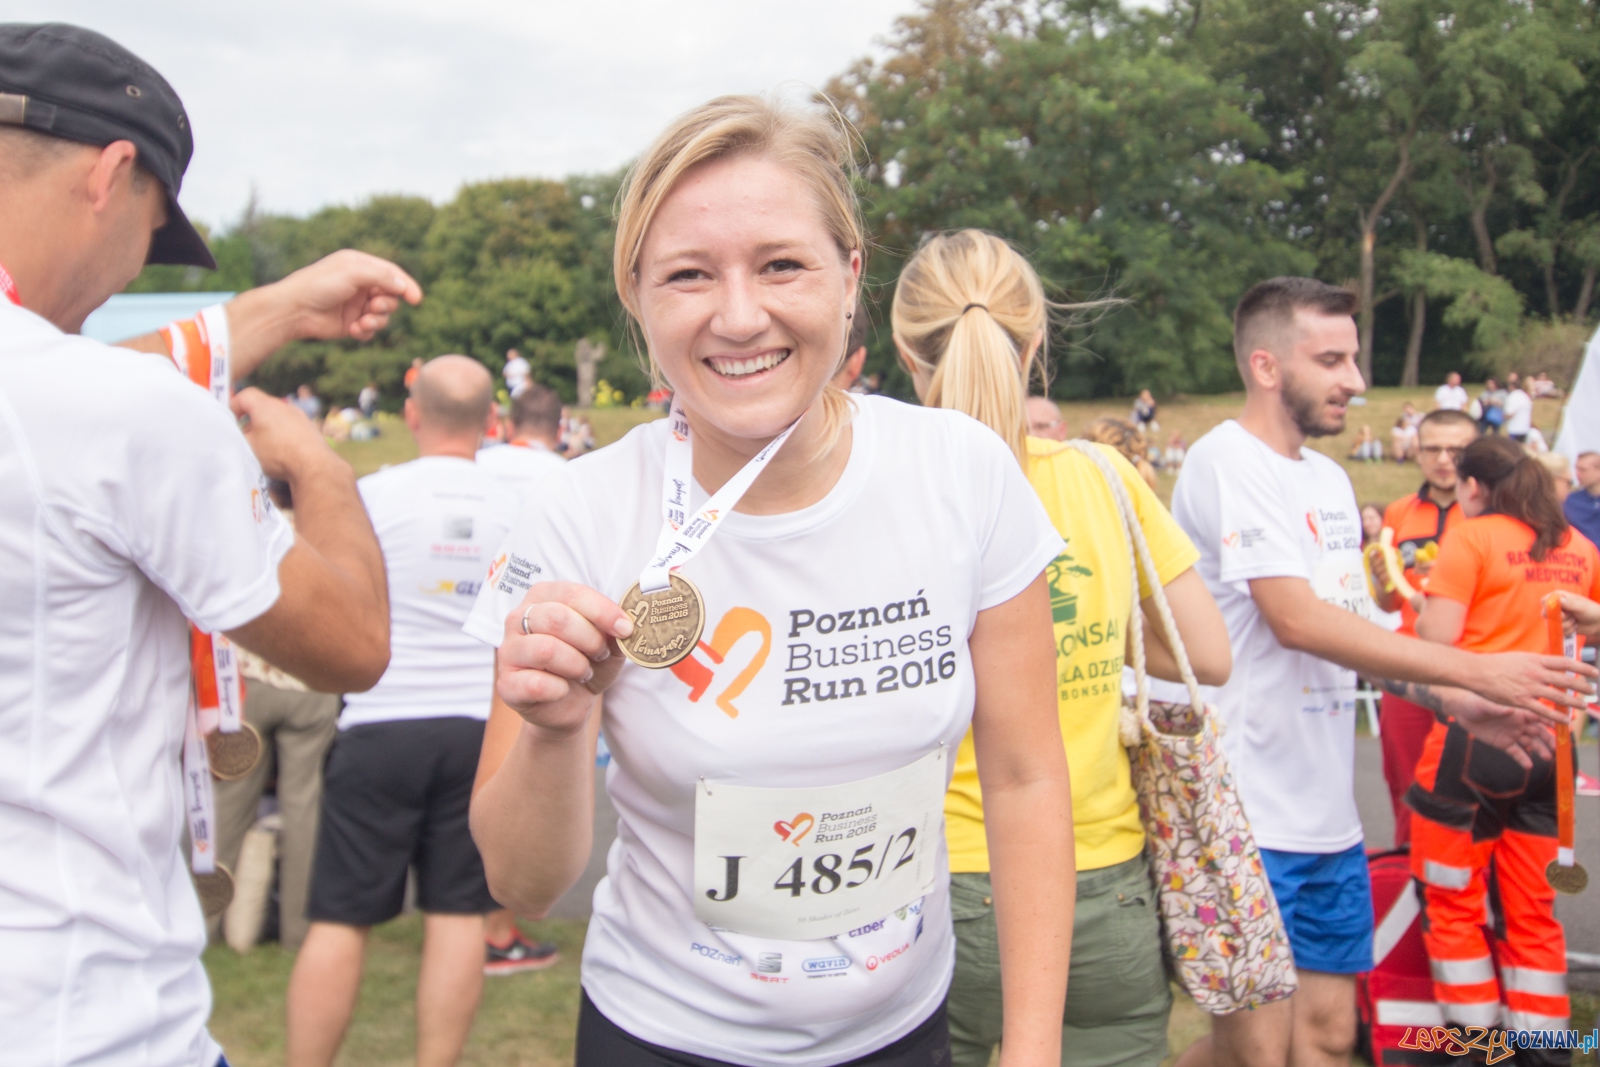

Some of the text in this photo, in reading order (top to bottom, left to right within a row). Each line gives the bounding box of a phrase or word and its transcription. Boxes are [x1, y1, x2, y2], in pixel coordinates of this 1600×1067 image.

[497, 581, 513, 594] Run
[501, 571, 533, 591] Busines
[650, 594, 684, 608] Poznań
[650, 601, 688, 616] Business
[650, 609, 689, 624] Run 2016
[788, 589, 931, 638] Poznań
[785, 625, 953, 672] Business
[1056, 618, 1119, 659] ONSAI
[781, 651, 957, 706] Run 2016
[817, 813, 878, 834] Business
[820, 804, 873, 823] Poznań
[814, 822, 878, 844] Run 2016
[705, 855, 748, 902] J
[773, 827, 917, 898] 485/2
[880, 942, 910, 963] VEOLIA
[808, 957, 846, 970] wavin
[750, 972, 790, 984] SEAT
